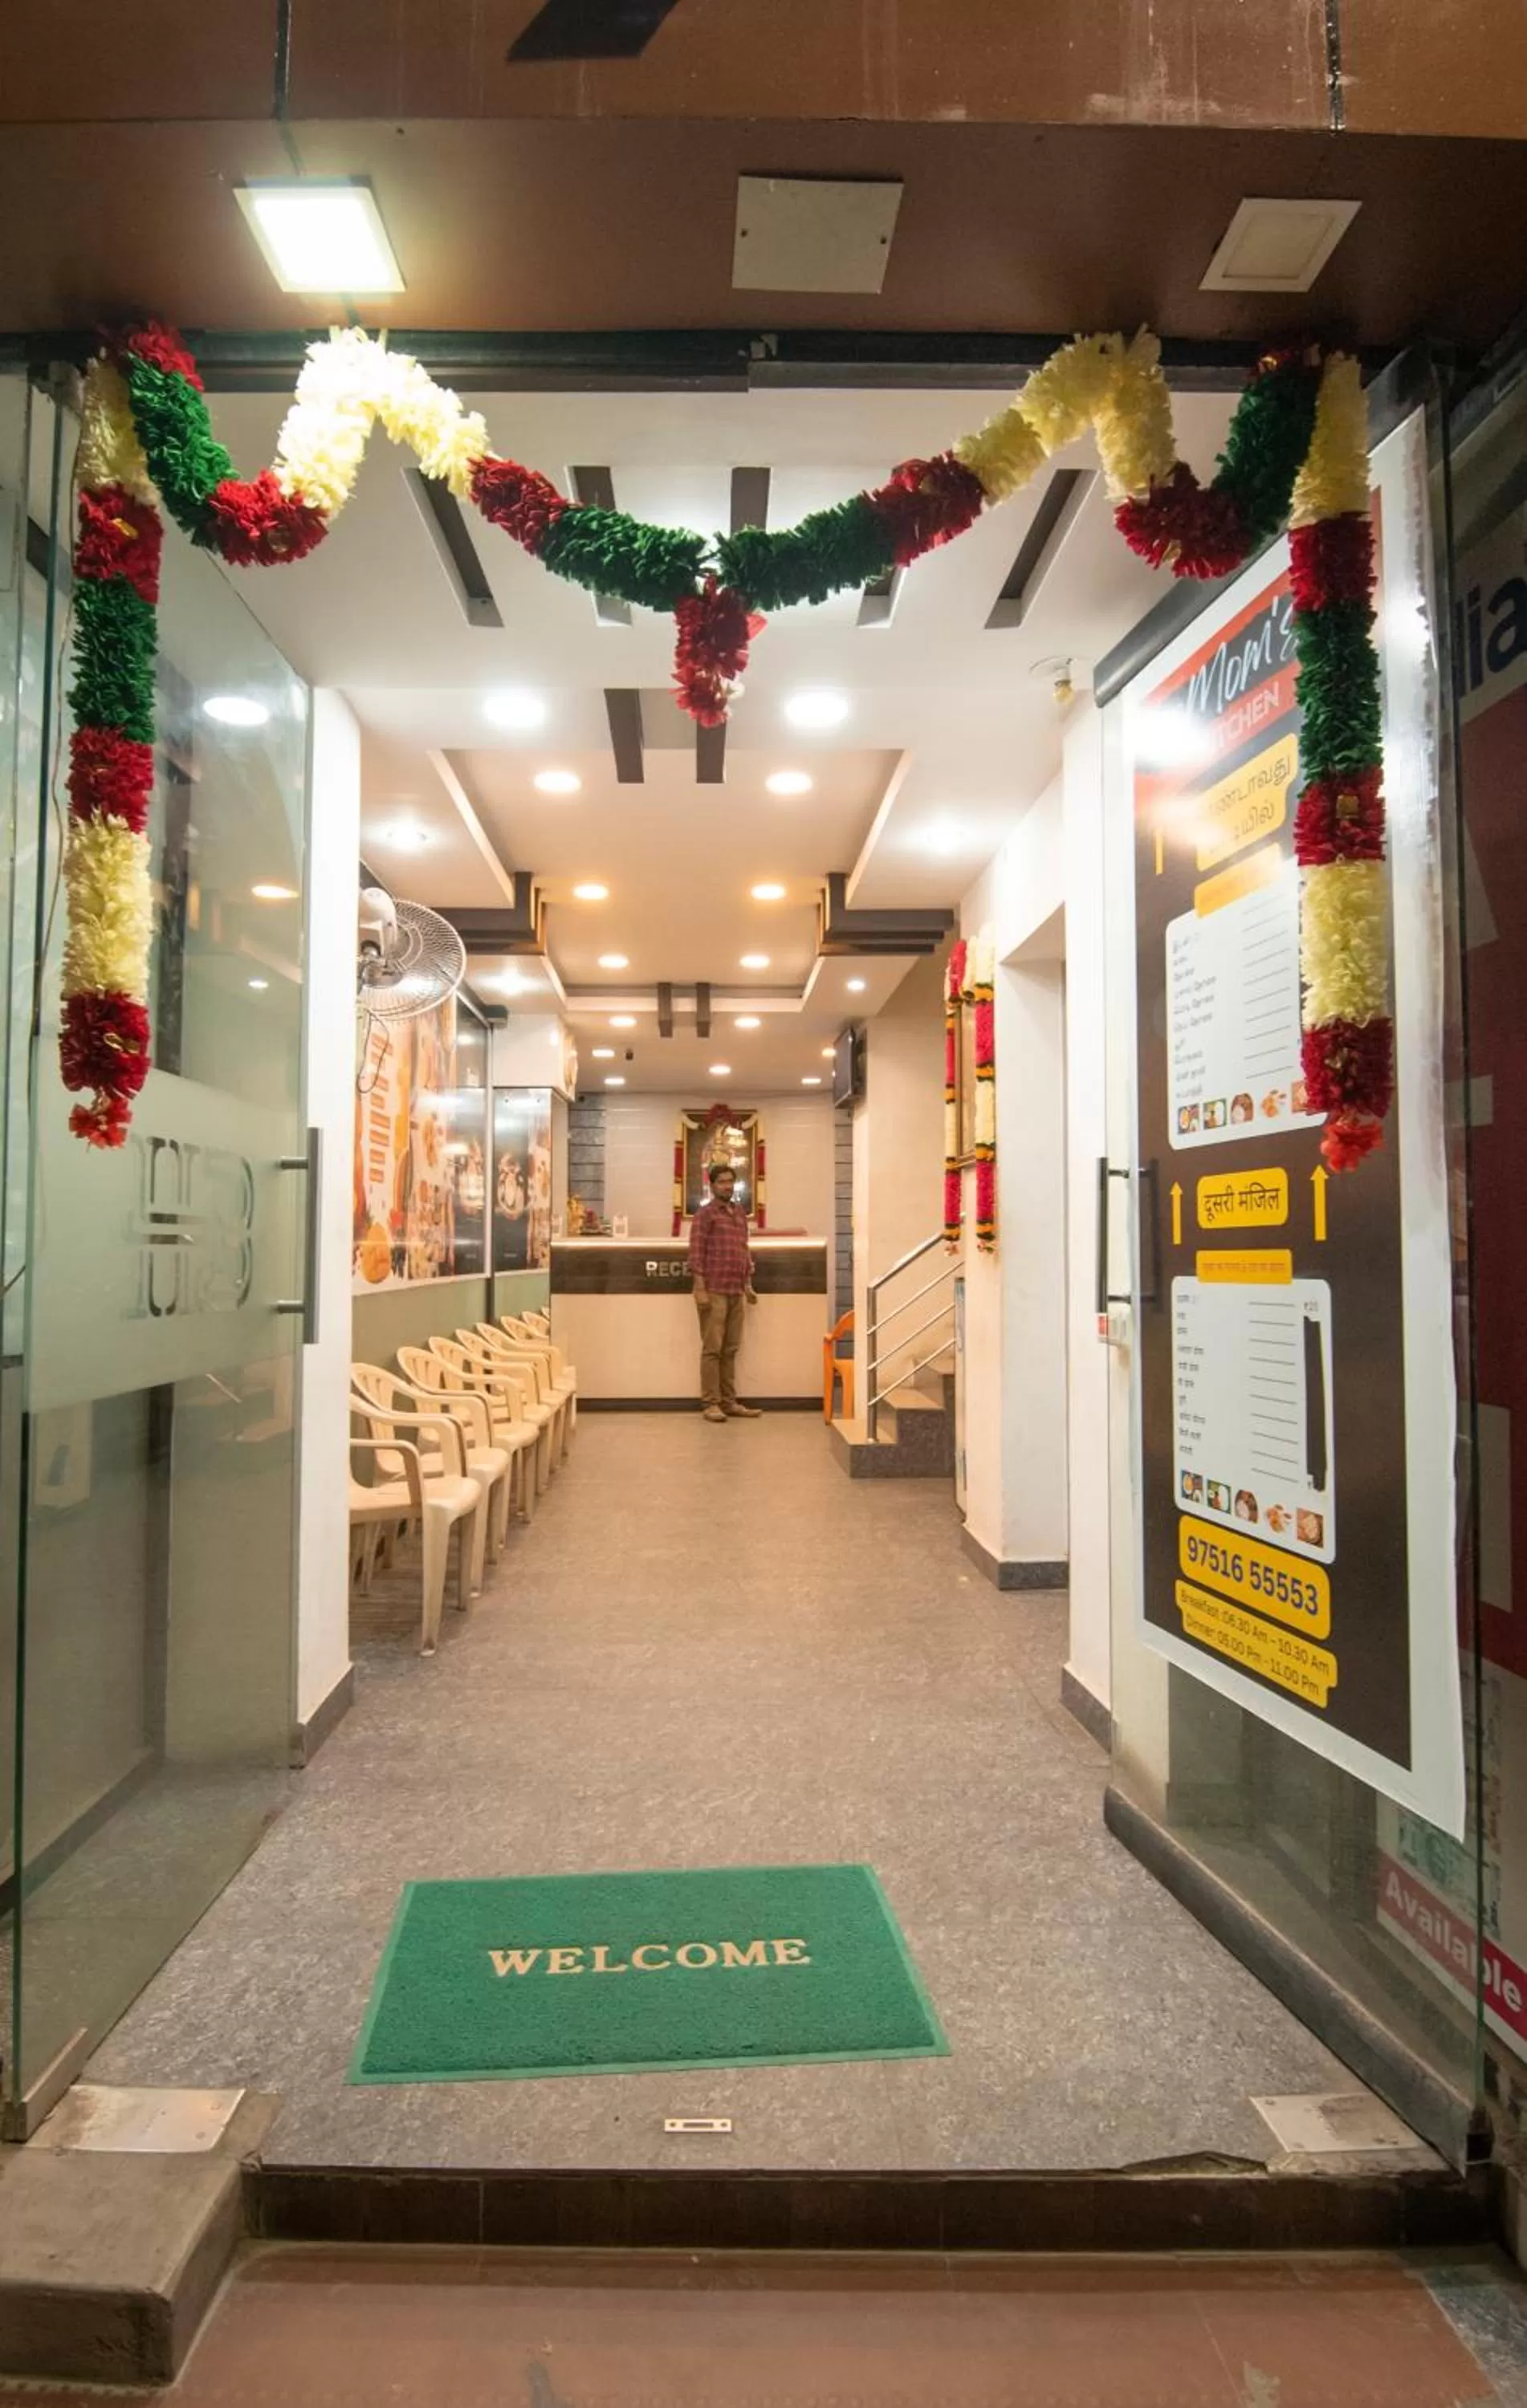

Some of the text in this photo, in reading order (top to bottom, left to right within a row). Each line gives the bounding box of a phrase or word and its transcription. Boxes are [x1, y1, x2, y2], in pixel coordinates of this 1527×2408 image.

[1187, 1535, 1319, 1617] 97516 55553
[489, 1938, 812, 1977] WELCOME
